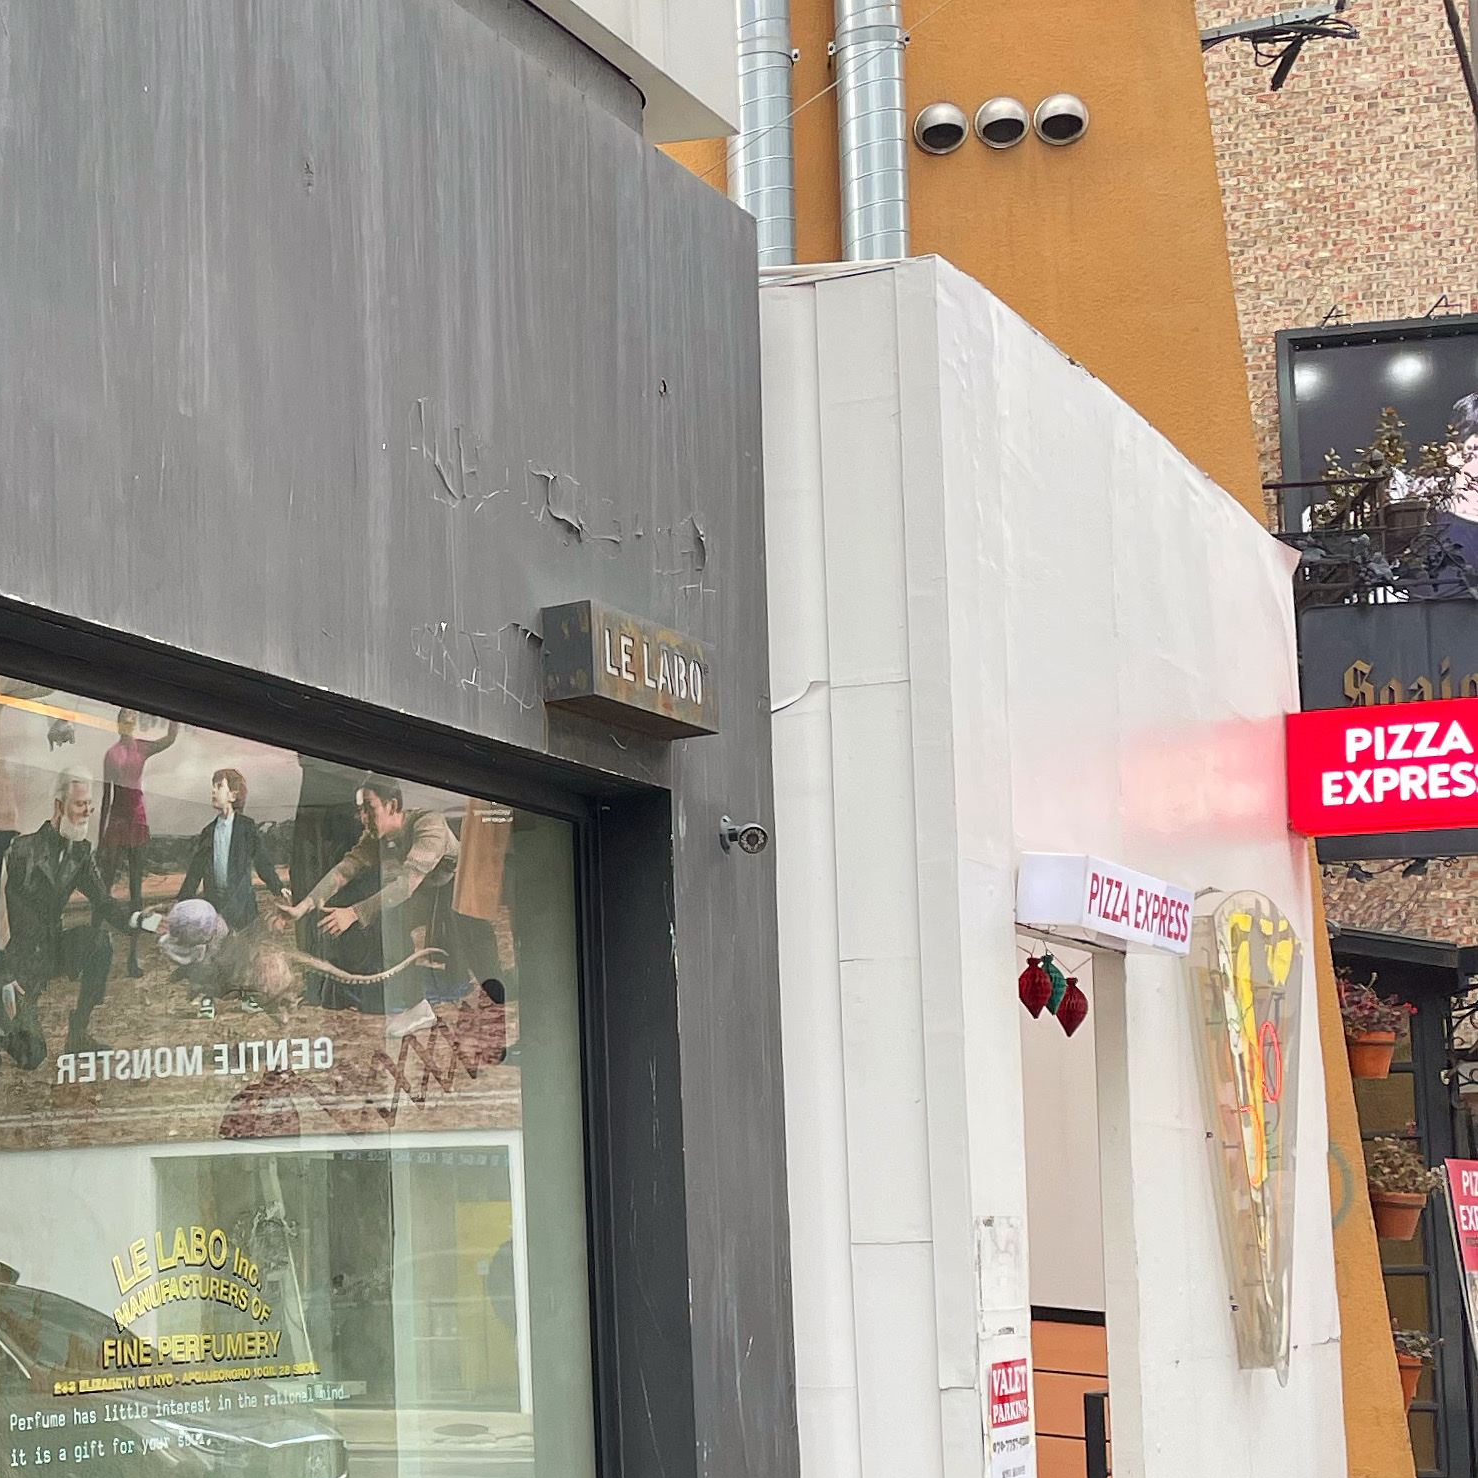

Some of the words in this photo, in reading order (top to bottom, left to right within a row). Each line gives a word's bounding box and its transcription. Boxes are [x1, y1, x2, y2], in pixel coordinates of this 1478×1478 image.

[604, 628, 636, 682] LE
[642, 641, 703, 705] LABO
[1345, 720, 1475, 763] PIZZA
[1322, 761, 1478, 806] EXPRES
[1087, 872, 1130, 926] PIZZA
[1133, 888, 1190, 943] EXPRESS
[112, 1237, 153, 1296] LE
[155, 1225, 228, 1271] LABO
[113, 1273, 249, 1332] MANUFACTURERS
[250, 1296, 272, 1325] OF
[102, 1337, 153, 1368] FINE
[157, 1331, 282, 1365] PERFUMERY
[992, 1364, 1027, 1397] VALET
[9, 1411, 66, 1432] Perfume
[73, 1408, 97, 1425] has
[104, 1402, 149, 1422] little
[156, 1396, 211, 1417] interest
[217, 1394, 232, 1411] in
[238, 1393, 258, 1409] the
[263, 1386, 314, 1407] rational
[992, 1398, 1029, 1424] PARKING
[10, 1448, 27, 1467] it
[34, 1446, 52, 1465] is
[58, 1448, 67, 1461] a
[73, 1440, 105, 1463] gift
[112, 1437, 135, 1456] for
[142, 1435, 171, 1456] your
